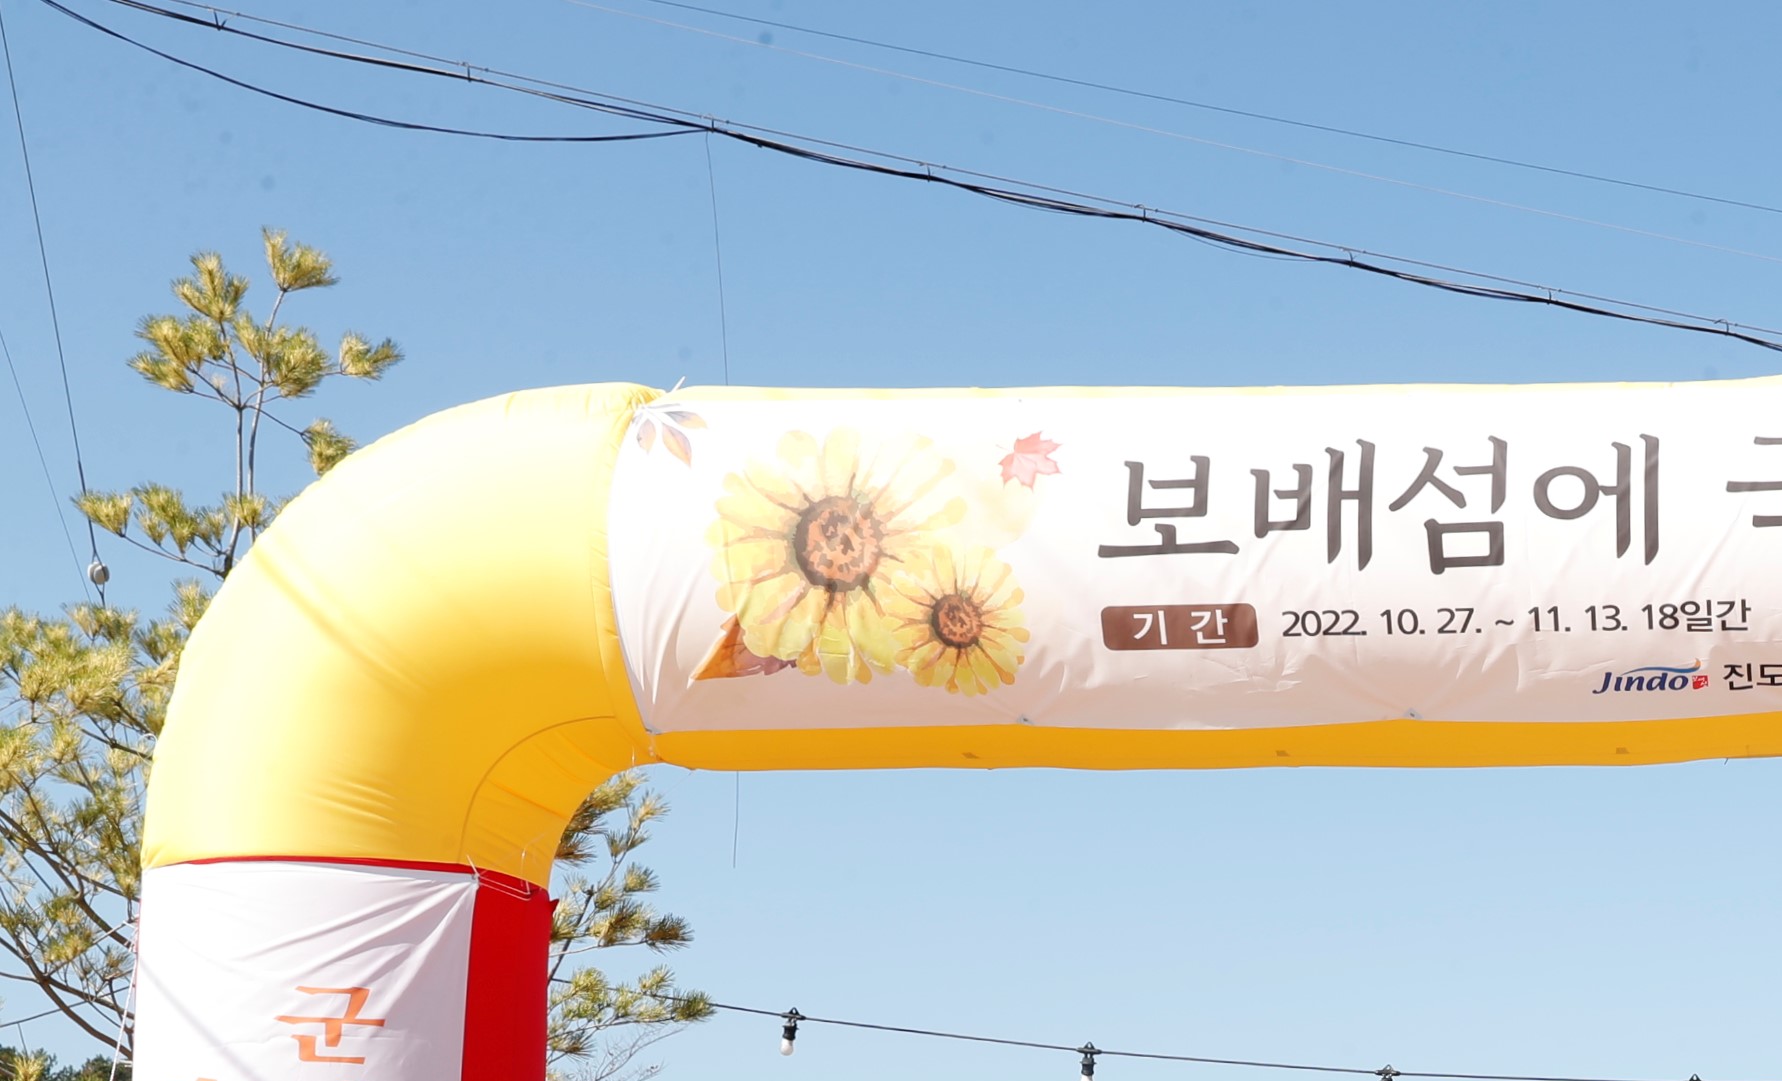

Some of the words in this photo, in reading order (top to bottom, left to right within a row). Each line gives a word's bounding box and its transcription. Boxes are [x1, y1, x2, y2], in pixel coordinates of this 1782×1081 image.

[1097, 433, 1660, 576] 보배섬에
[1282, 609, 1368, 638] 2022.
[1380, 608, 1427, 635] 10.
[1437, 607, 1483, 635] 27.
[1528, 605, 1572, 633] 11.
[1584, 604, 1629, 632] 13.
[1641, 598, 1752, 633] 18일간
[1592, 671, 1690, 695] Jindo
